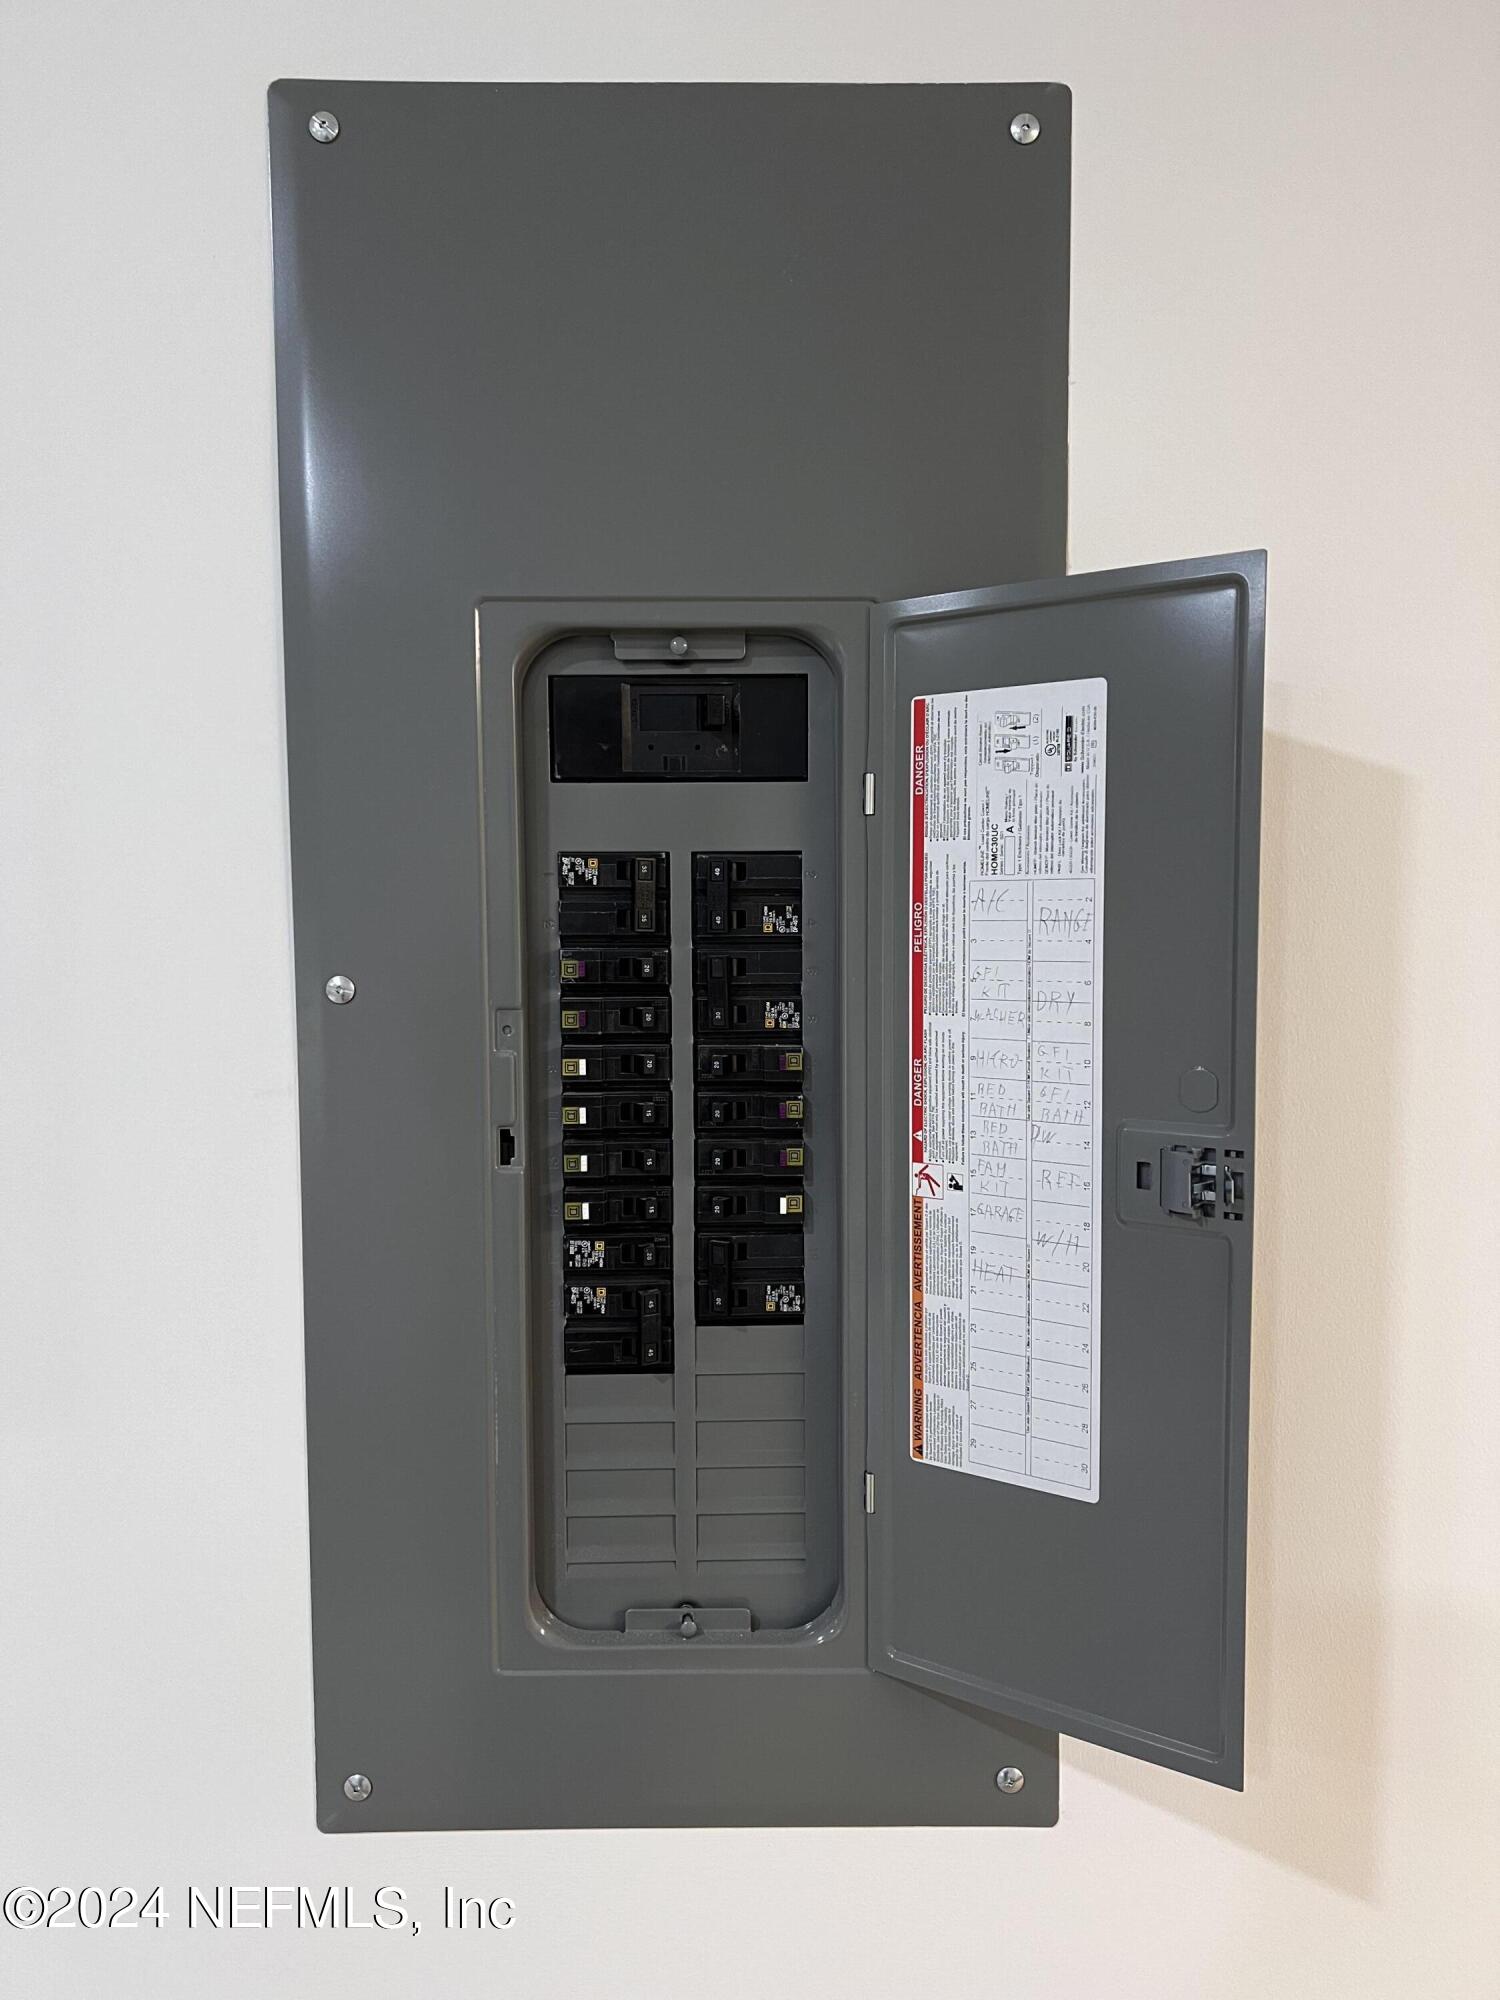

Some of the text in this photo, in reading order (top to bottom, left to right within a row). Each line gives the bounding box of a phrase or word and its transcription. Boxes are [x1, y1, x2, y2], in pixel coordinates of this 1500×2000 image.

[915, 744, 924, 796] DANGER
[641, 865, 648, 873] 35
[714, 868, 720, 876] 40
[974, 888, 1009, 915] A/C
[641, 914, 648, 922] 35
[715, 916, 721, 925] 40
[914, 902, 922, 952] PELIGRO
[644, 965, 650, 973] 20
[1036, 990, 1076, 1015] DRY
[645, 1014, 652, 1022] 20
[715, 1011, 721, 1019] 30
[647, 1060, 653, 1068] 20
[713, 1061, 720, 1069] 20
[1084, 1060, 1091, 1069] 10
[1040, 1064, 1074, 1081] KIT
[914, 1058, 922, 1106] DANGER
[970, 1092, 977, 1100] 11
[1084, 1101, 1091, 1109] 12
[714, 1110, 720, 1118] 20
[970, 1130, 977, 1139] 13
[1084, 1141, 1091, 1149] 14
[646, 1158, 653, 1166] 15
[714, 1157, 720, 1165] 20
[971, 1169, 977, 1177] 15
[1084, 1182, 1091, 1191] 16
[714, 1205, 720, 1213] 20
[970, 1208, 977, 1216] 17
[1084, 1223, 1091, 1231] 18
[970, 1246, 977, 1254] 19
[973, 1258, 1019, 1283] HEAT
[1083, 1262, 1090, 1272] 20
[971, 1286, 977, 1294] 21
[648, 1300, 654, 1308] 45
[1082, 1303, 1089, 1313] 22
[913, 1198, 922, 1440] WARNING ADVERTENCIA AVERTISSEMENT
[971, 1324, 977, 1333] 23
[648, 1349, 654, 1357] 45
[1082, 1344, 1089, 1354] 24
[971, 1362, 977, 1371] 25
[1082, 1384, 1089, 1394] 26
[971, 1400, 977, 1410] 27
[1082, 1424, 1088, 1433] 28
[970, 1439, 977, 1448] 29
[1081, 1464, 1088, 1473] 30
